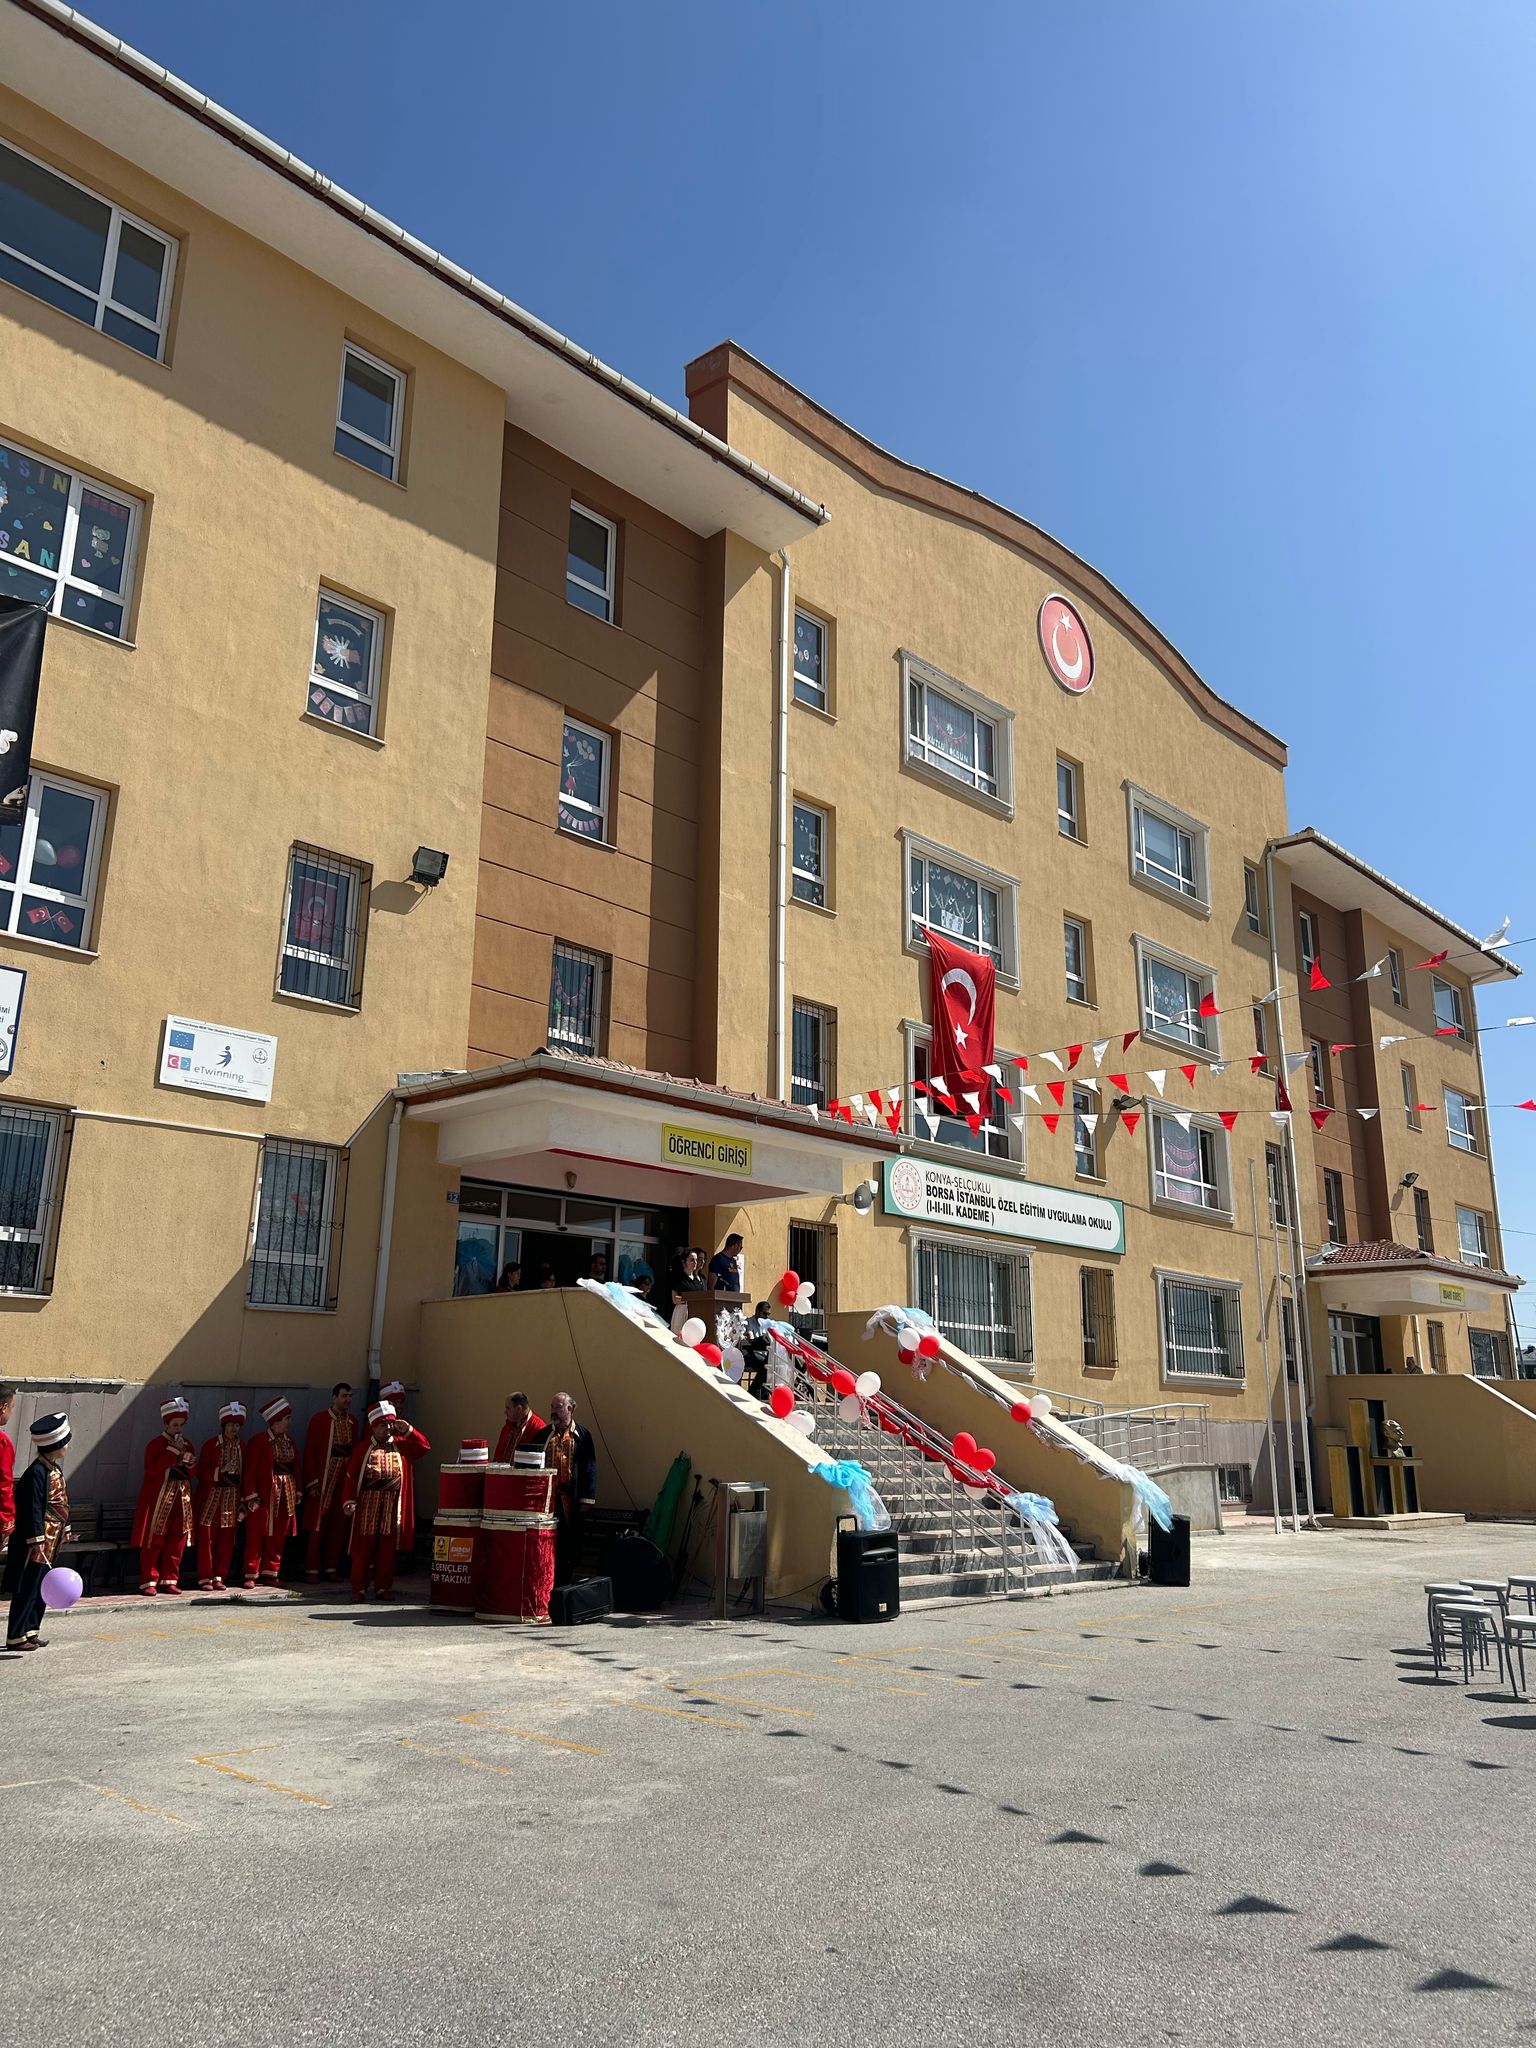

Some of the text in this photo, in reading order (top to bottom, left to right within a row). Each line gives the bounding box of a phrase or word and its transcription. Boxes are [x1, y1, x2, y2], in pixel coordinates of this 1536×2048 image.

[194, 1066, 244, 1083] eTwinning
[669, 1133, 748, 1168] ÖĞRENCİ GİRİŞİ
[925, 1170, 991, 1194] KONYA-SELÇUKLU
[926, 1184, 1112, 1231] BORSA İSTANBUL ÖZEL EĞİTİM UYGULAMA OKULU
[956, 1205, 990, 1222] KADEME
[435, 1563, 469, 1573] GENÇLER
[441, 1574, 471, 1584] TAKIMI
